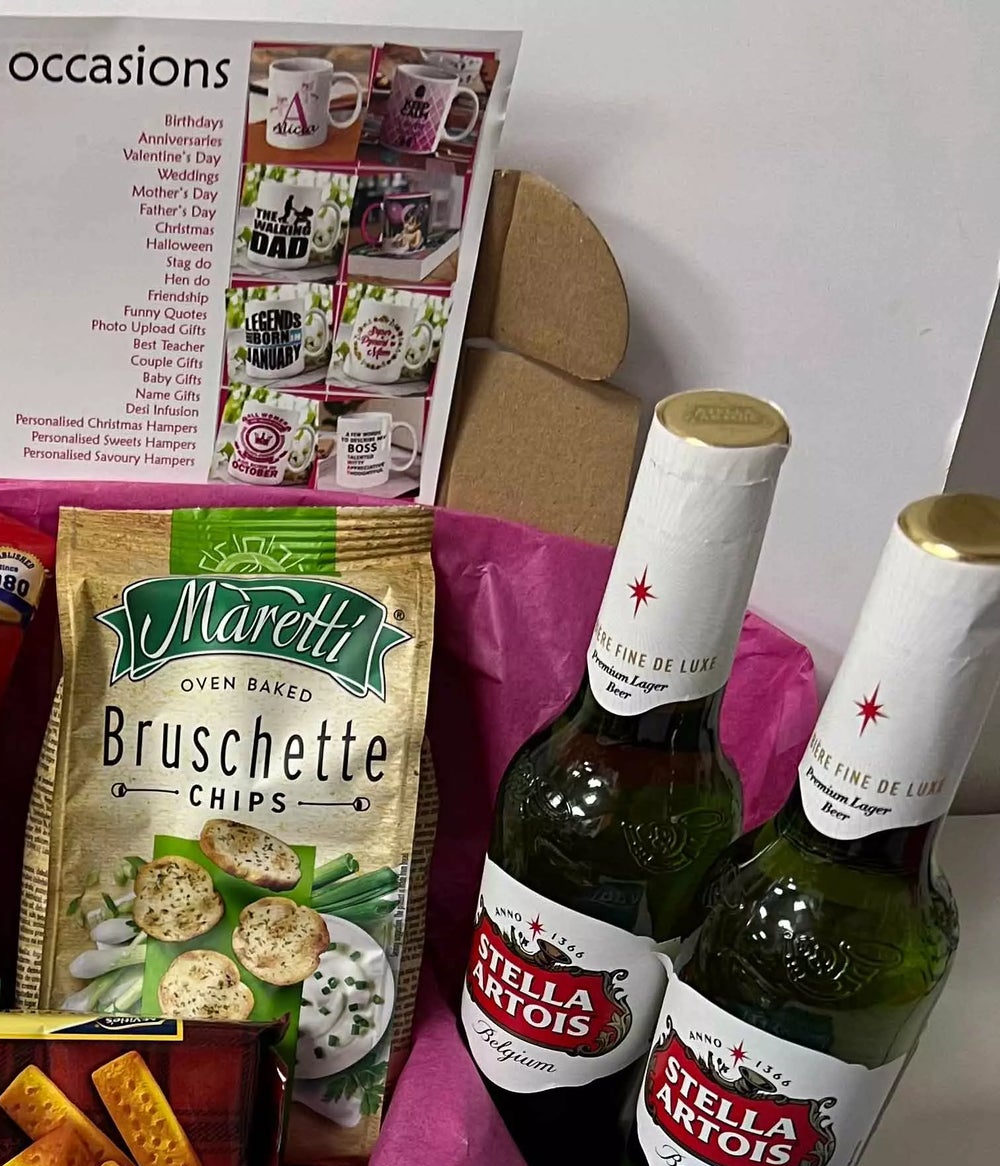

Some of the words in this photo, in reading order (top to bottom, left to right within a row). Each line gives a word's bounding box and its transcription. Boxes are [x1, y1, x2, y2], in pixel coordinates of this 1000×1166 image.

[9, 45, 231, 89] occasions
[165, 114, 223, 131] Birthdays
[139, 132, 222, 147] Anniversaries
[123, 149, 190, 163] Valentine's
[196, 152, 221, 167] Day
[158, 168, 219, 185] Weddings
[132, 185, 188, 199] Mother's
[193, 188, 218, 202] Day
[140, 203, 187, 216] Father's
[192, 205, 216, 220] Day
[256, 208, 278, 222] THE
[155, 222, 214, 236] Christmas
[254, 219, 311, 236] WALKING
[146, 238, 213, 252] Halloween
[251, 230, 309, 259] DAD
[166, 256, 191, 270] Stag
[196, 257, 212, 270] do
[164, 273, 189, 285] Hen
[194, 274, 210, 286] do
[149, 289, 208, 305] Friendship
[124, 305, 160, 320] Funny
[165, 308, 207, 320] Quotes
[246, 309, 301, 332] LEGENDS
[92, 320, 127, 332] Photo
[131, 322, 175, 335] Upload
[179, 324, 206, 336] Gifts
[134, 338, 156, 350] Best
[162, 340, 205, 352] Teacher
[254, 330, 289, 344] BORN
[131, 355, 172, 369] Couple
[177, 357, 203, 369] Gifts
[143, 372, 172, 386] Baby
[176, 373, 201, 385] Gifts
[136, 388, 170, 400] Name
[174, 390, 200, 401] Gifts
[126, 403, 149, 415] Desi
[154, 404, 199, 417] Infusion
[16, 414, 83, 428] Personalised
[88, 418, 142, 431] Christmas
[147, 421, 197, 434] Hampers
[32, 431, 99, 445] Personalised
[104, 435, 141, 447] Sweets
[146, 437, 196, 451] Hampers
[348, 443, 377, 453] BOSS
[24, 447, 91, 461] Personalised
[95, 452, 140, 466] Savoury
[144, 454, 195, 467] Hampers
[232, 461, 278, 477] OCTOBER
[181, 676, 235, 693] OVEN
[248, 677, 312, 702] BAKED
[104, 706, 387, 782] Bruschette
[835, 763, 872, 789] FINE
[877, 780, 901, 796] DE
[190, 785, 286, 813] CHIPS
[850, 798, 892, 816] Lager
[821, 802, 850, 821] Beer
[495, 907, 522, 922] ANNO
[477, 933, 594, 1012] STELLA
[471, 963, 591, 1038] ARTOIS
[472, 1019, 557, 1074] Belgium
[689, 1030, 722, 1047] ANNO
[663, 1054, 797, 1142] STELLA
[655, 1089, 793, 1166] ARTOIS
